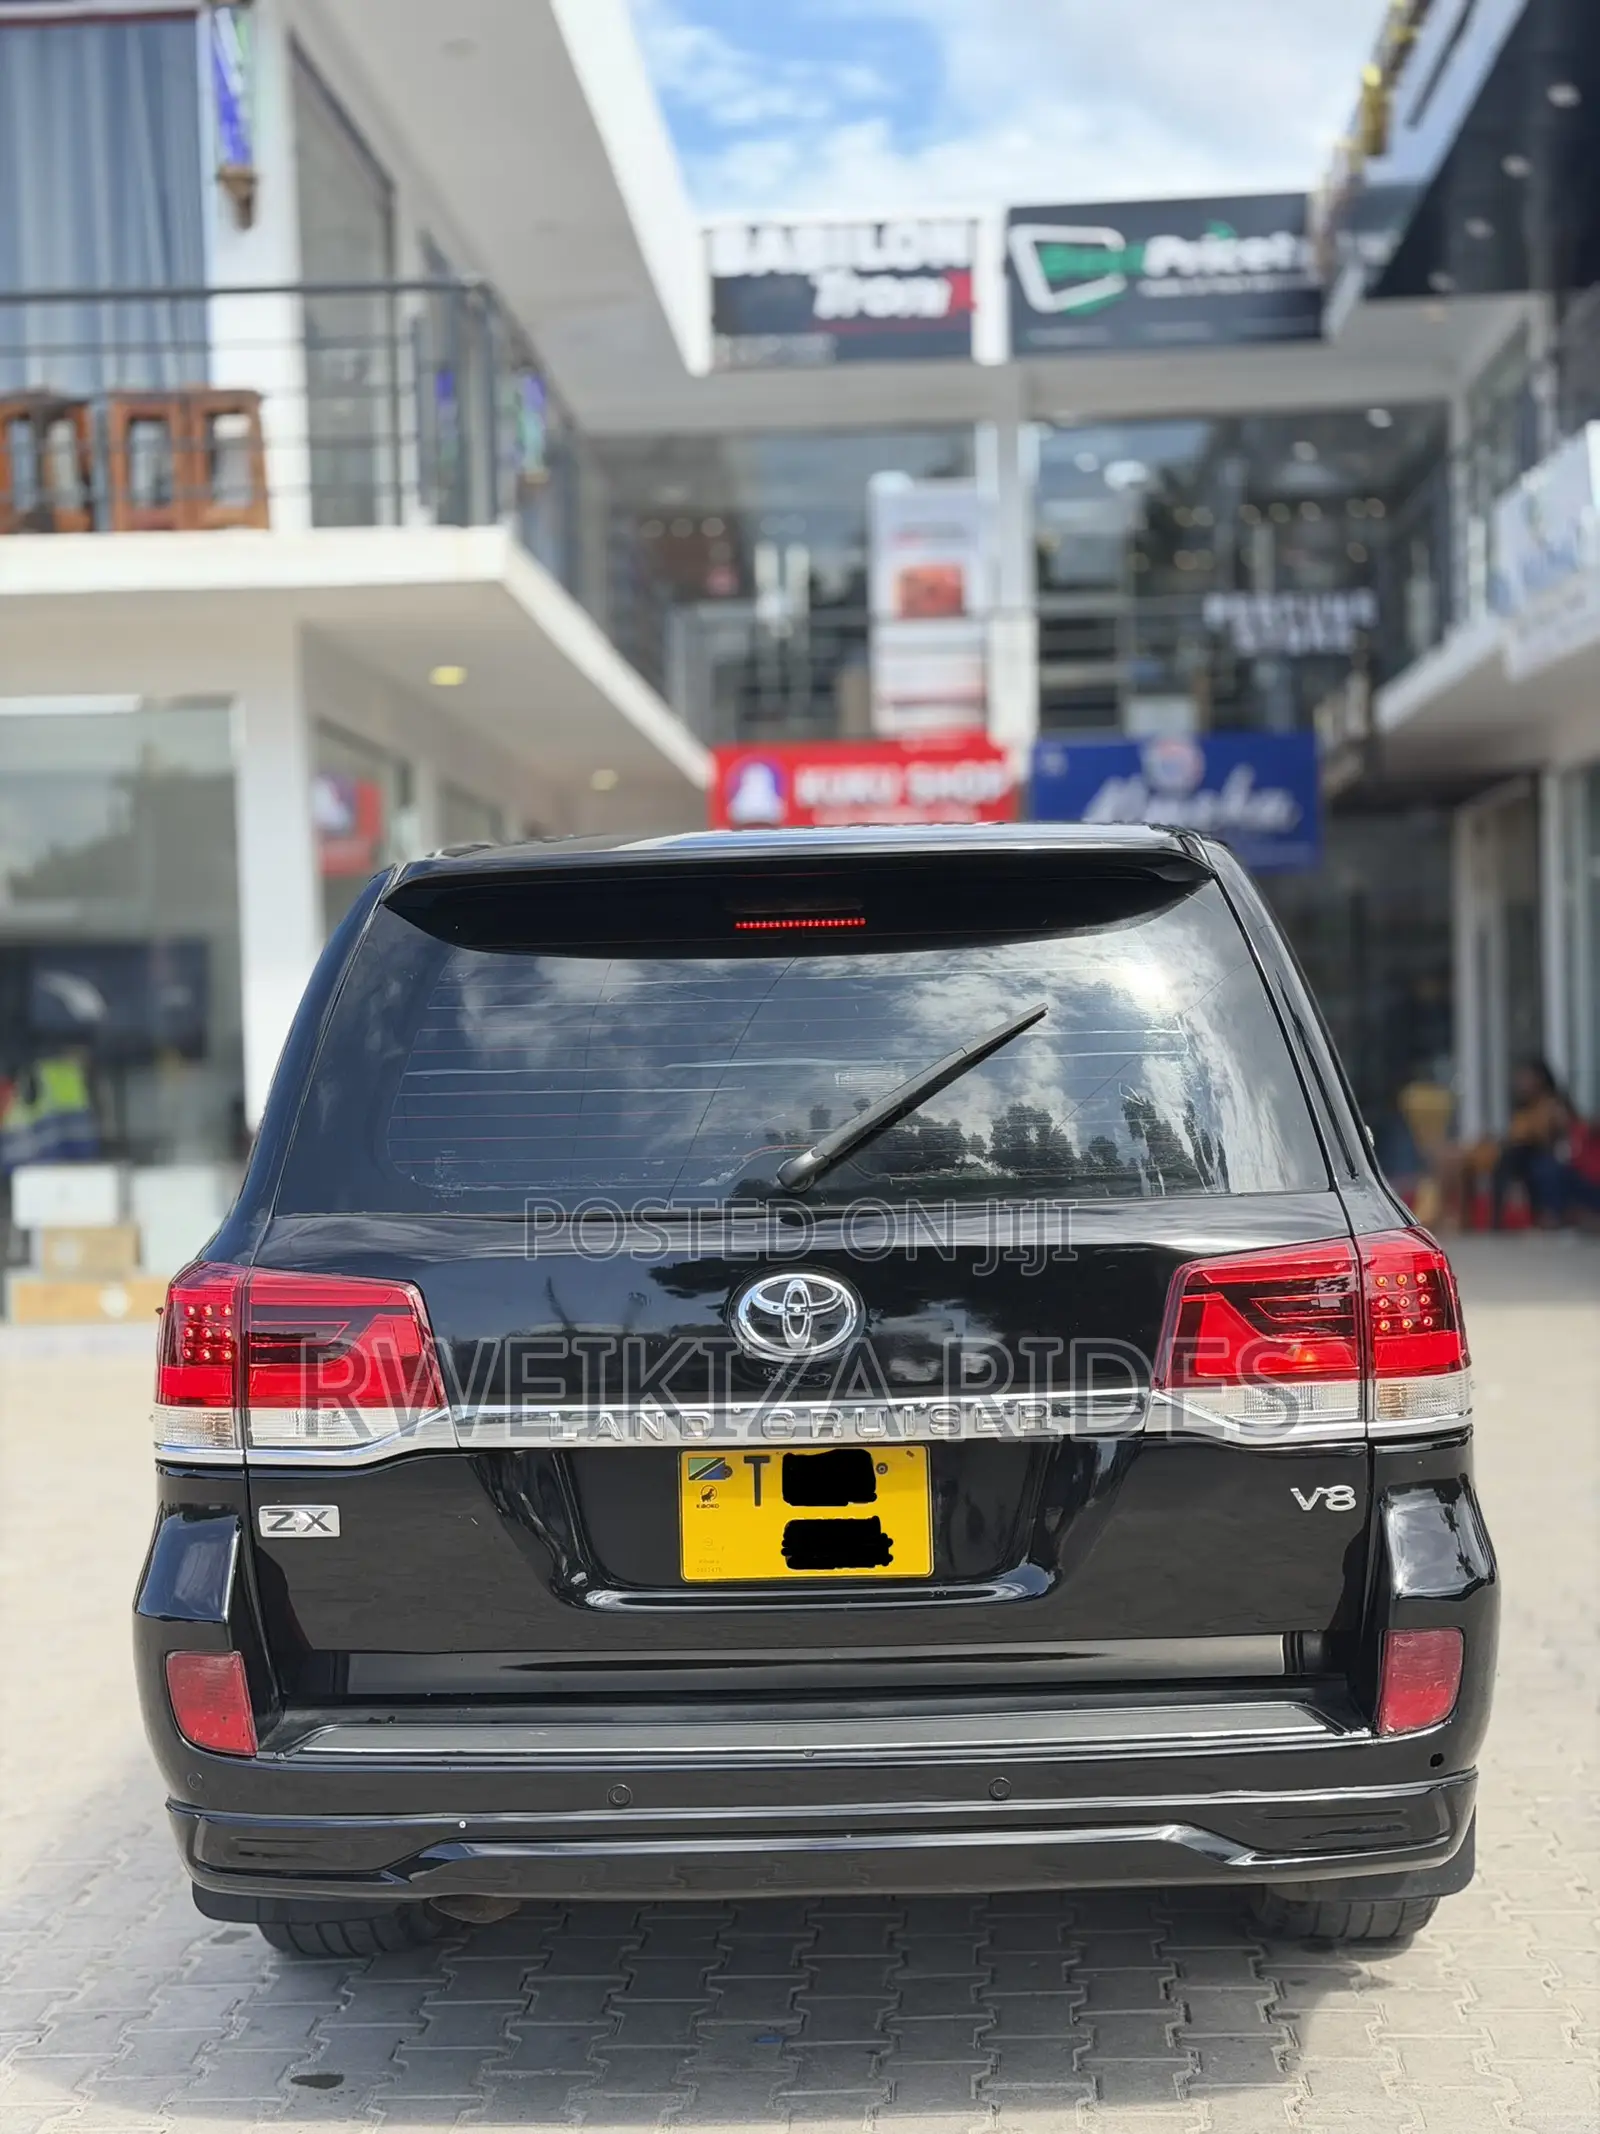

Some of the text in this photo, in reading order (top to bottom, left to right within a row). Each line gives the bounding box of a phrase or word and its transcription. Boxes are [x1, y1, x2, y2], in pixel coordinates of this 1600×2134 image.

[549, 1399, 1053, 1442] LAND CRUISER
[743, 1455, 771, 1507] T
[1290, 1485, 1357, 1511] V8
[265, 1509, 334, 1533] ZX
